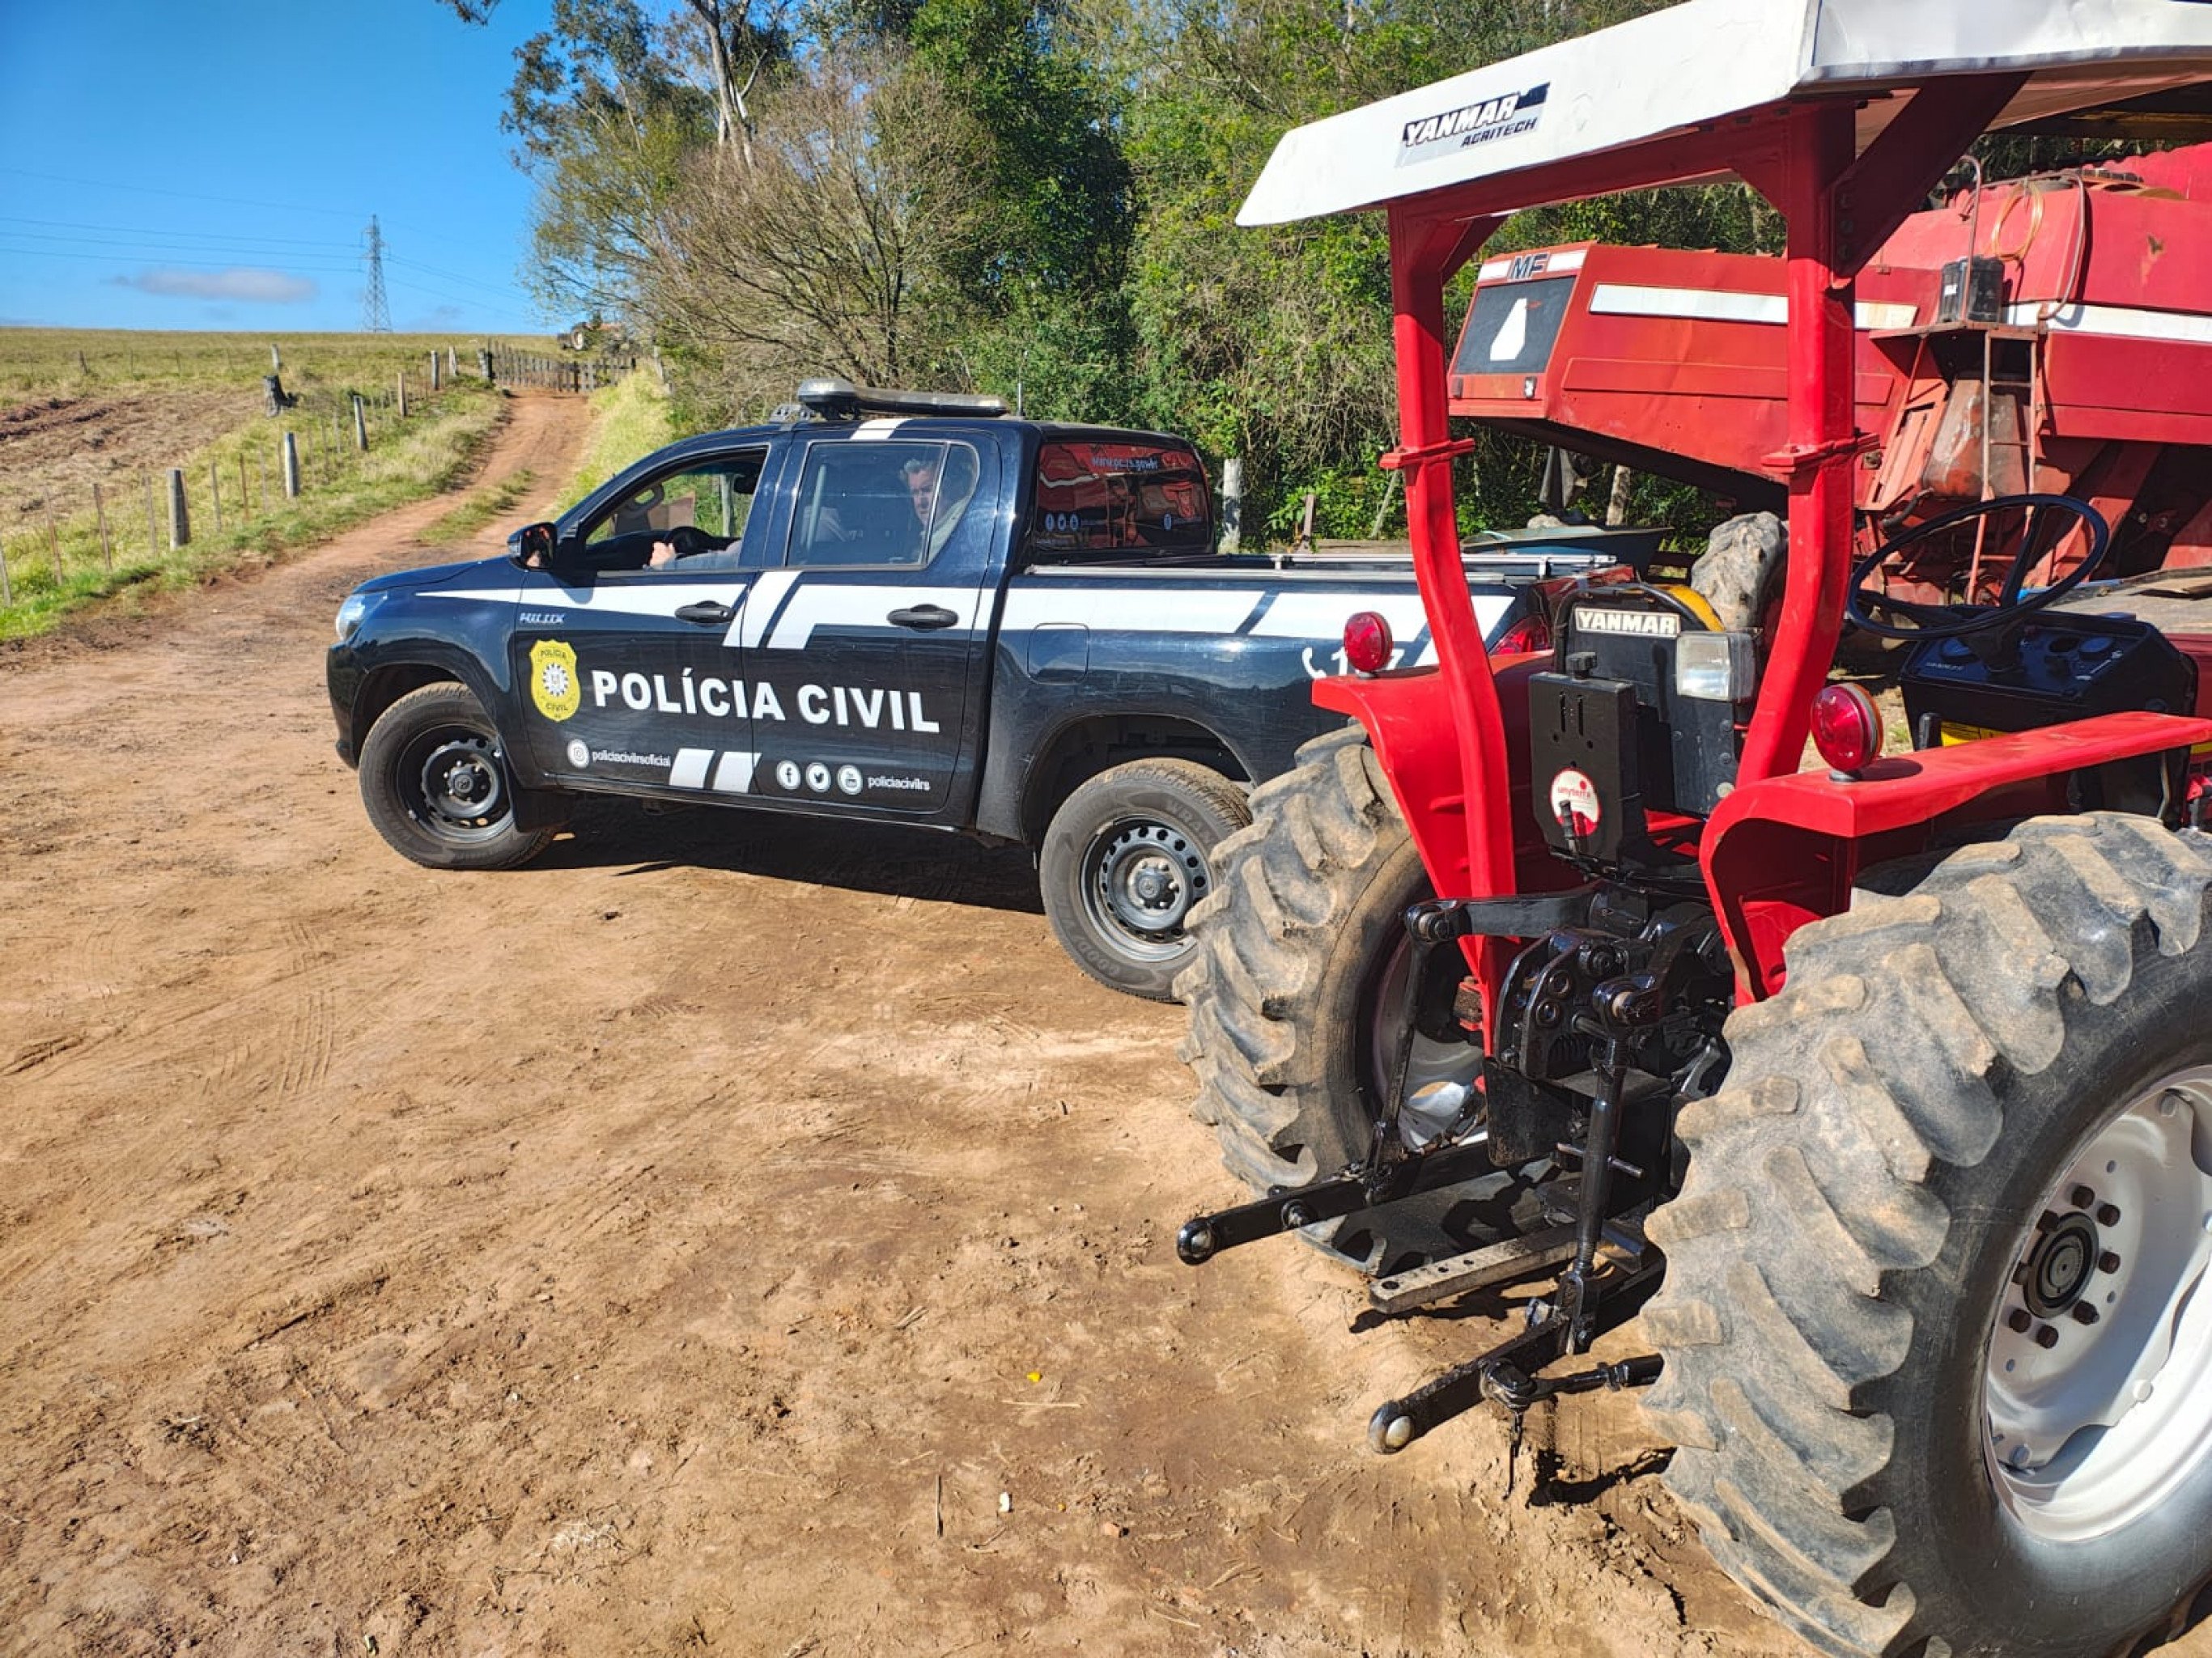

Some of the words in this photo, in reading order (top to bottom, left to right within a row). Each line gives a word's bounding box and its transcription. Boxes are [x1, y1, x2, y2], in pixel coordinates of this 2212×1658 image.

[1405, 94, 1521, 146] YANMAR
[1460, 117, 1538, 147] AGRITECH
[1510, 253, 1548, 279] MF
[519, 613, 565, 624] HILUX
[1578, 611, 1675, 634] YANMAR
[1331, 647, 1405, 676] 17
[592, 667, 786, 721] POLÍCIA
[796, 684, 940, 733] CIVIL
